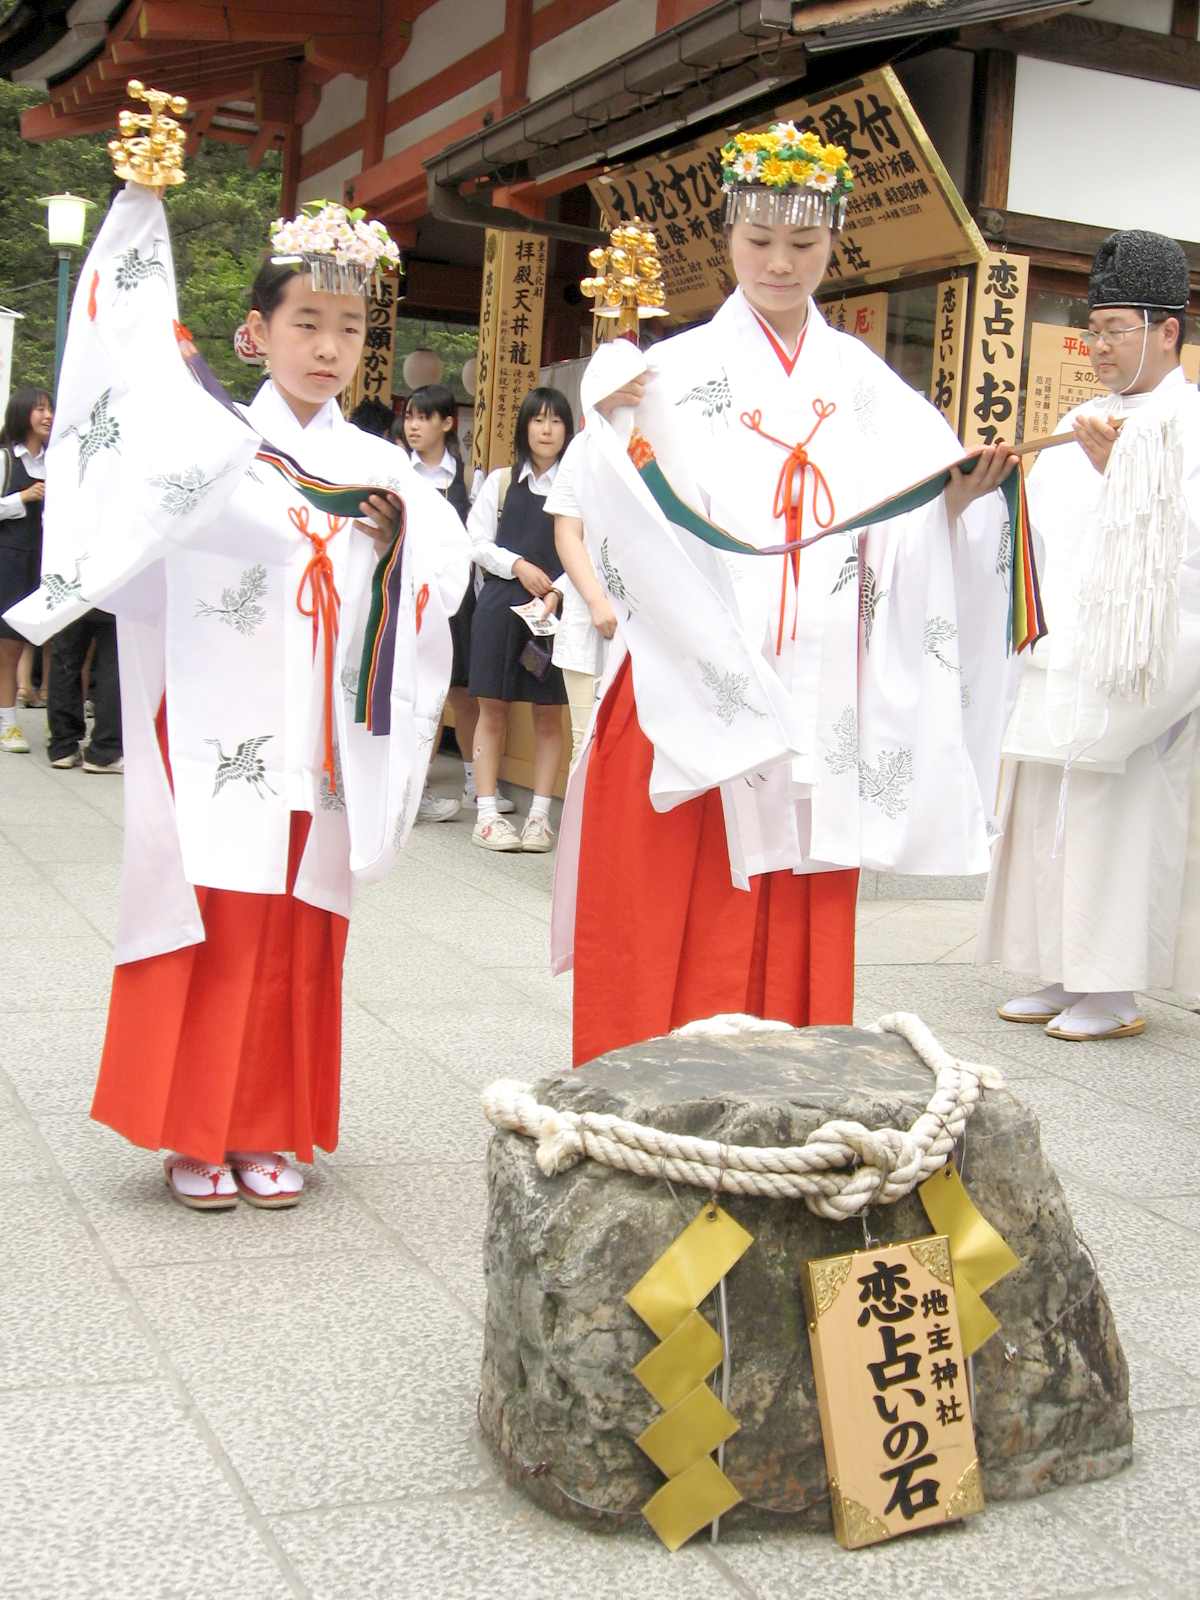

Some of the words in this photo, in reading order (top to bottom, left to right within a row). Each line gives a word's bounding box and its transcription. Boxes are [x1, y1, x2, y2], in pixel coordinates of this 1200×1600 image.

[363, 281, 394, 404] 恋の願かけ
[509, 239, 535, 366] 拝殿天井龍
[857, 1261, 940, 1519] 恋占いの石
[920, 1289, 964, 1426] 地主神社
